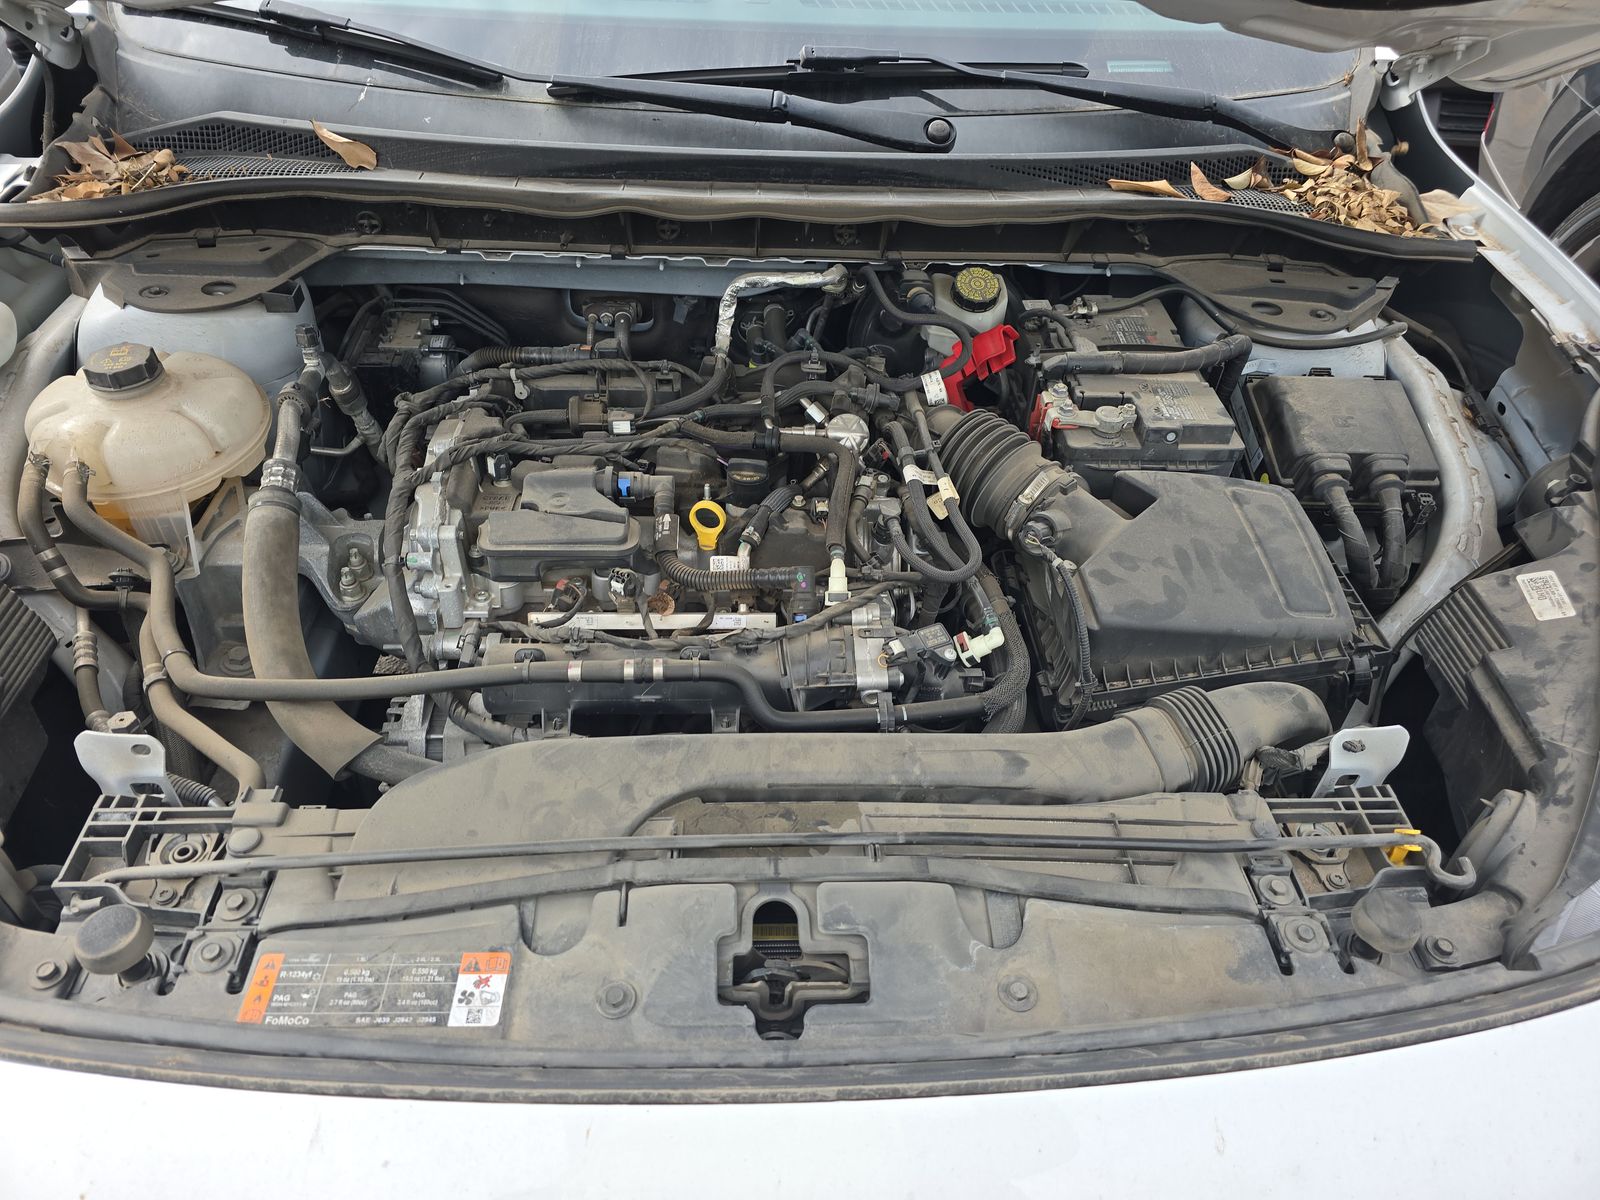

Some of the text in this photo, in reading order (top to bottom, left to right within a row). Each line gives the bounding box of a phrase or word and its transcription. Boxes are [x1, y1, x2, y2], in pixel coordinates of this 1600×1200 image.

[280, 970, 313, 980] R-1234yf
[361, 969, 370, 977] kg
[430, 967, 439, 976] kg
[272, 994, 291, 1002] PAG
[412, 991, 426, 999] PAG
[265, 1015, 310, 1026] FoMoCo
